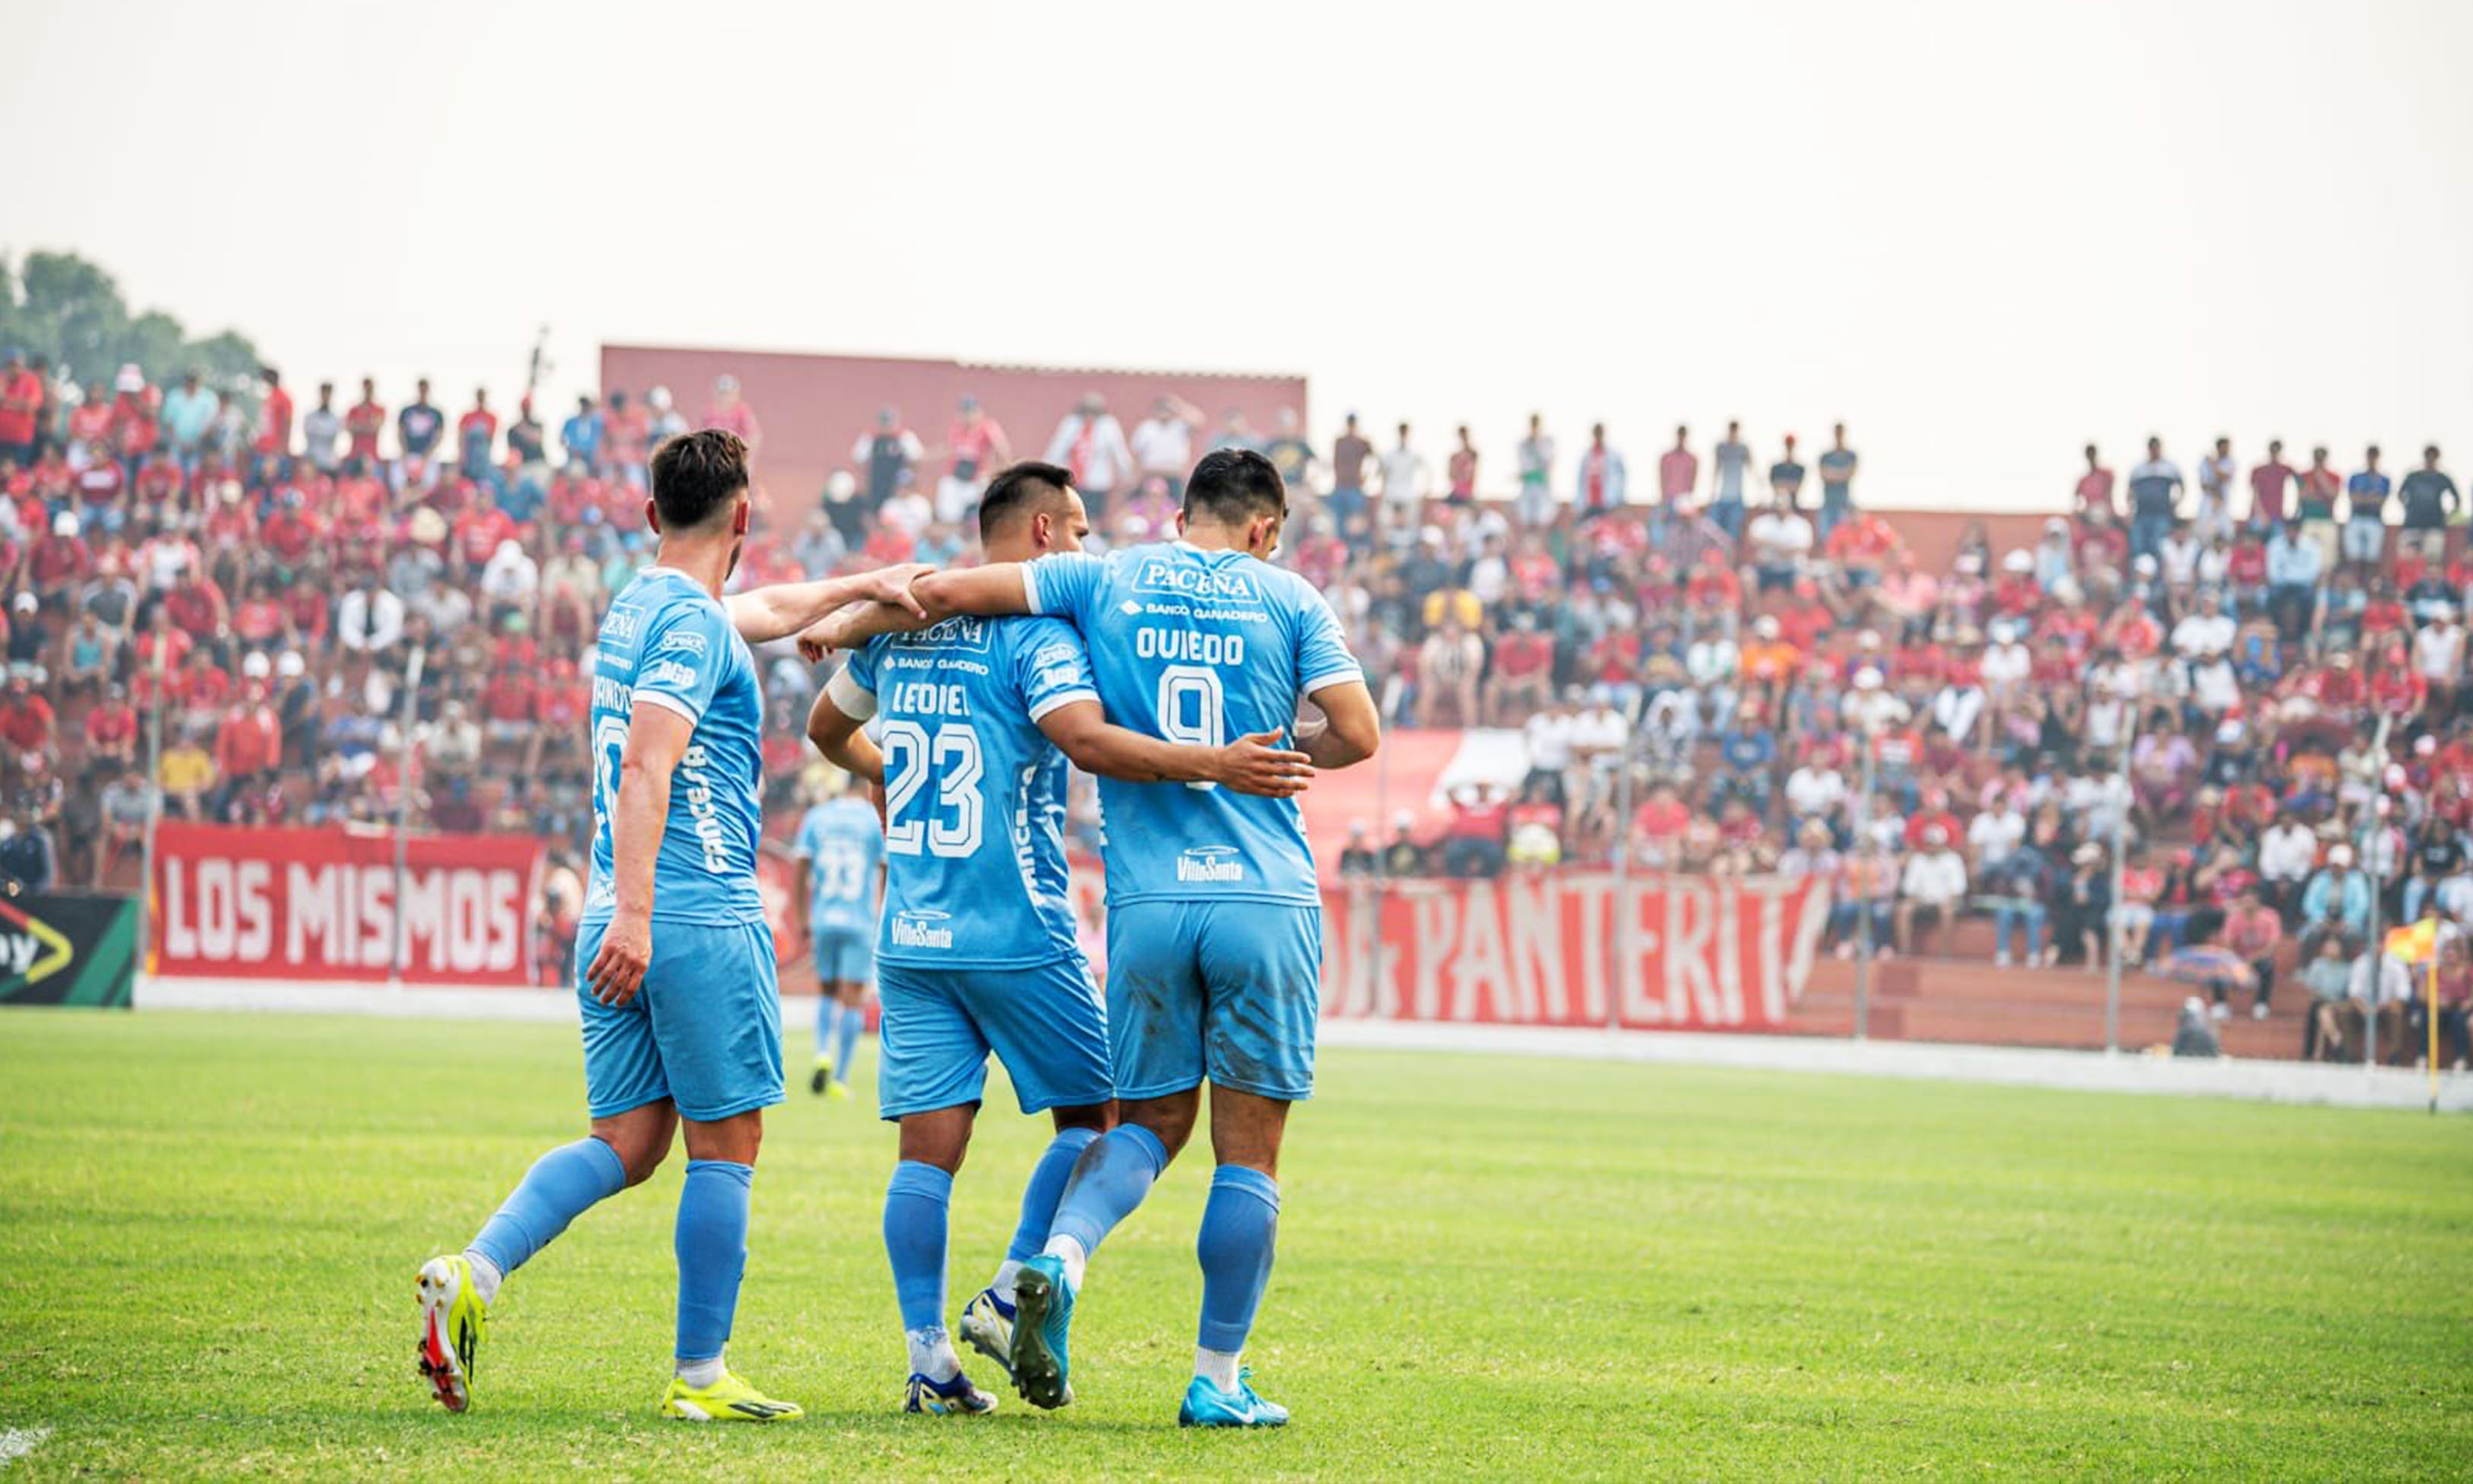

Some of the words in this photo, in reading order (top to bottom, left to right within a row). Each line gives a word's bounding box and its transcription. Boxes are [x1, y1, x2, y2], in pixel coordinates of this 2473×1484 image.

[1146, 602, 1190, 616] BANCO
[881, 719, 985, 858] 23
[164, 855, 273, 962] LOS
[286, 861, 519, 972] MISMOS
